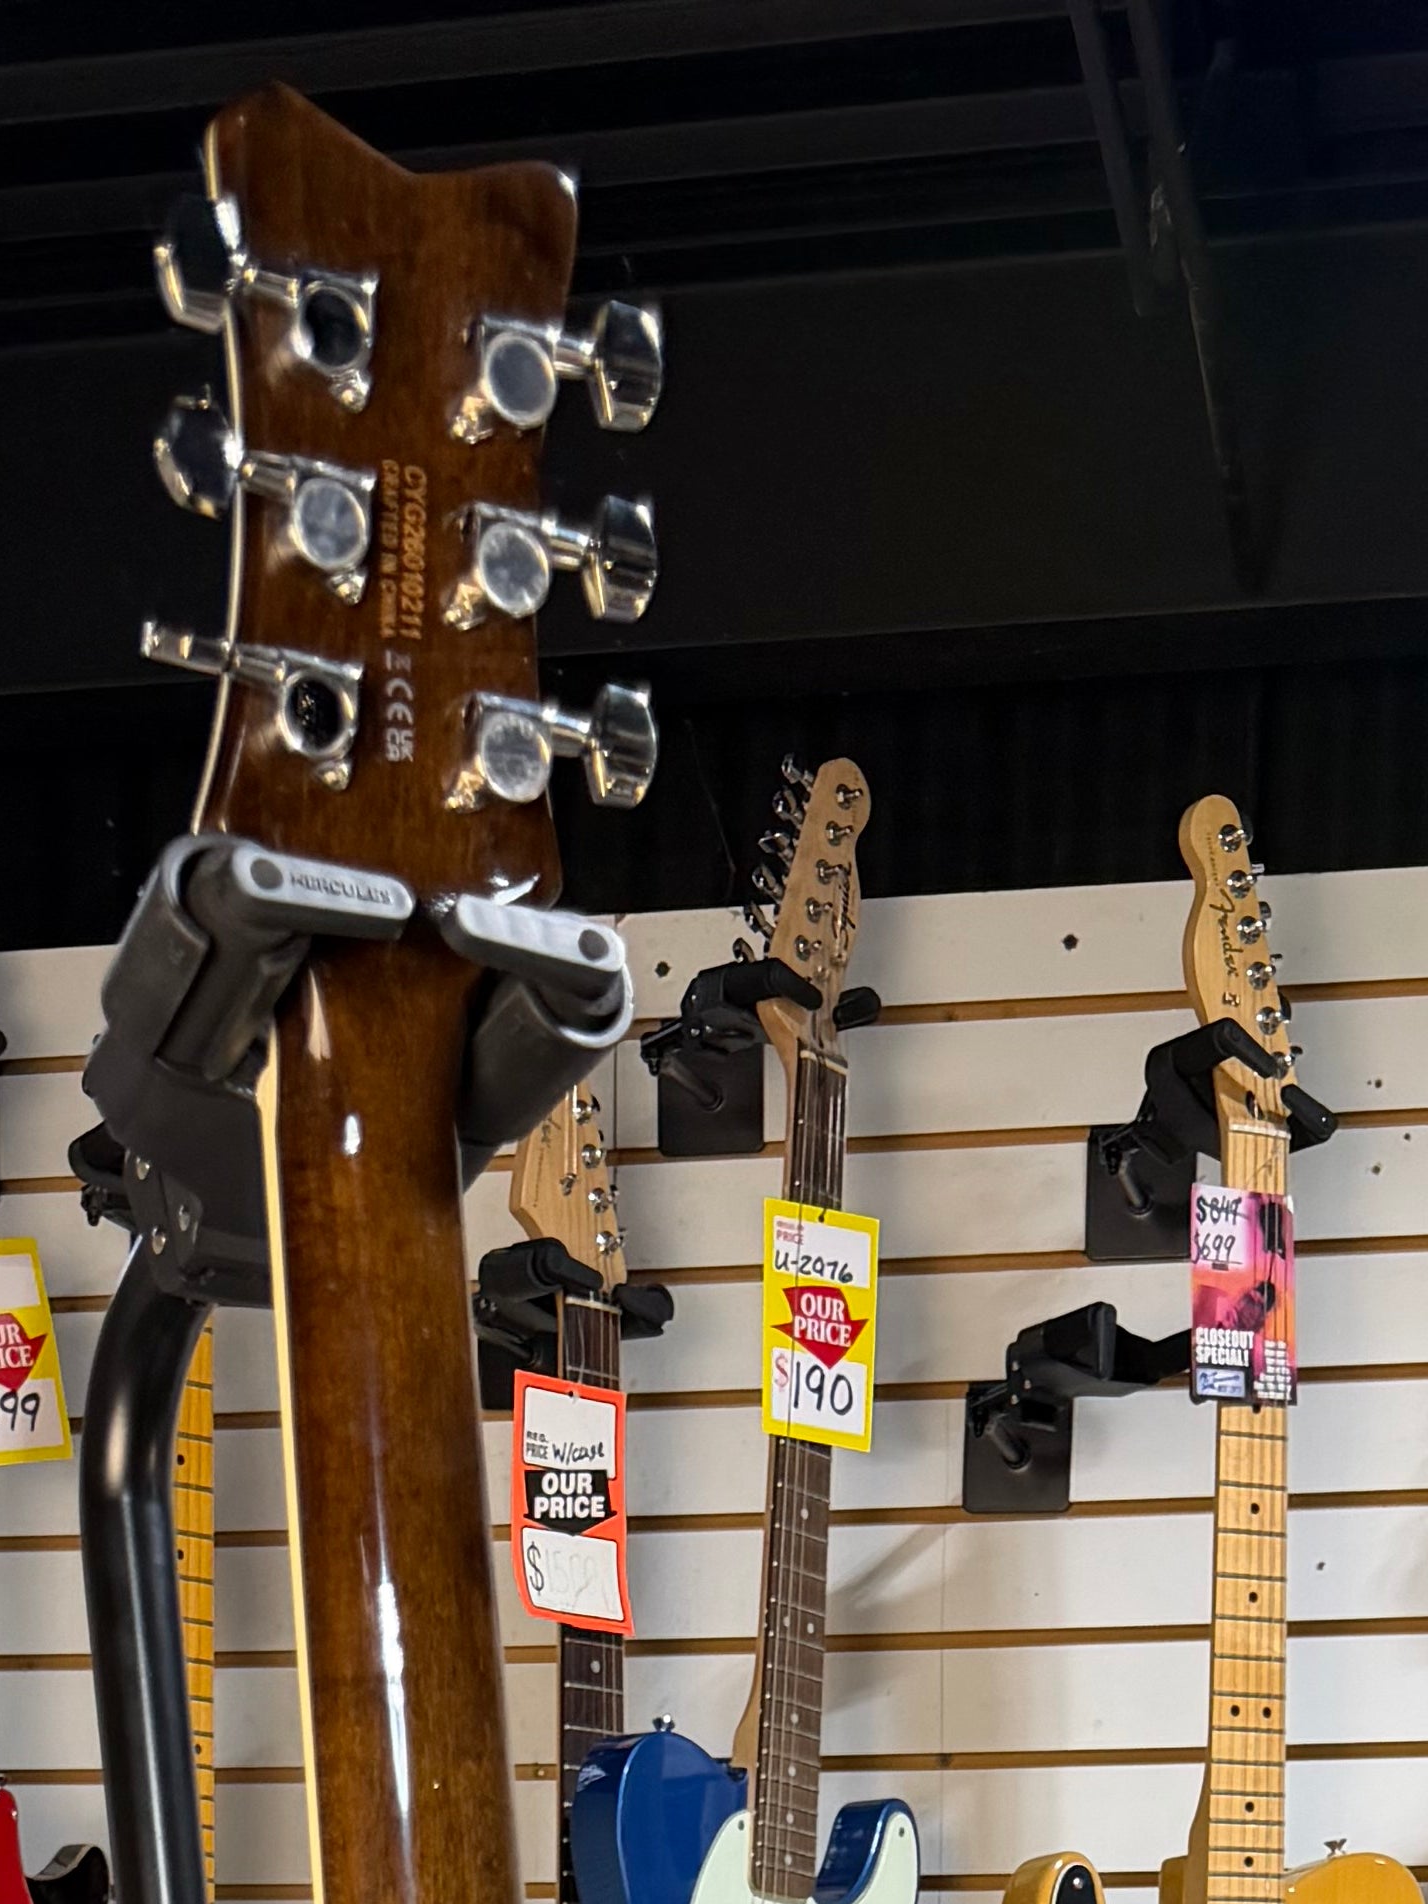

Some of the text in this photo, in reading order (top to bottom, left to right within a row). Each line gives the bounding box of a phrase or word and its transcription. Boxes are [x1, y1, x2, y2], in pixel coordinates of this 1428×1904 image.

[1209, 887, 1243, 979] Fender
[800, 1293, 846, 1321] OUR
[794, 1315, 852, 1348] PRICE
[1195, 1327, 1255, 1350] CLOSEOUT
[1195, 1345, 1250, 1367] SPECIAL!
[774, 1353, 854, 1416] $190
[526, 1443, 549, 1459] PRICE
[541, 1473, 593, 1495] OUR
[534, 1496, 606, 1519] PRICE
